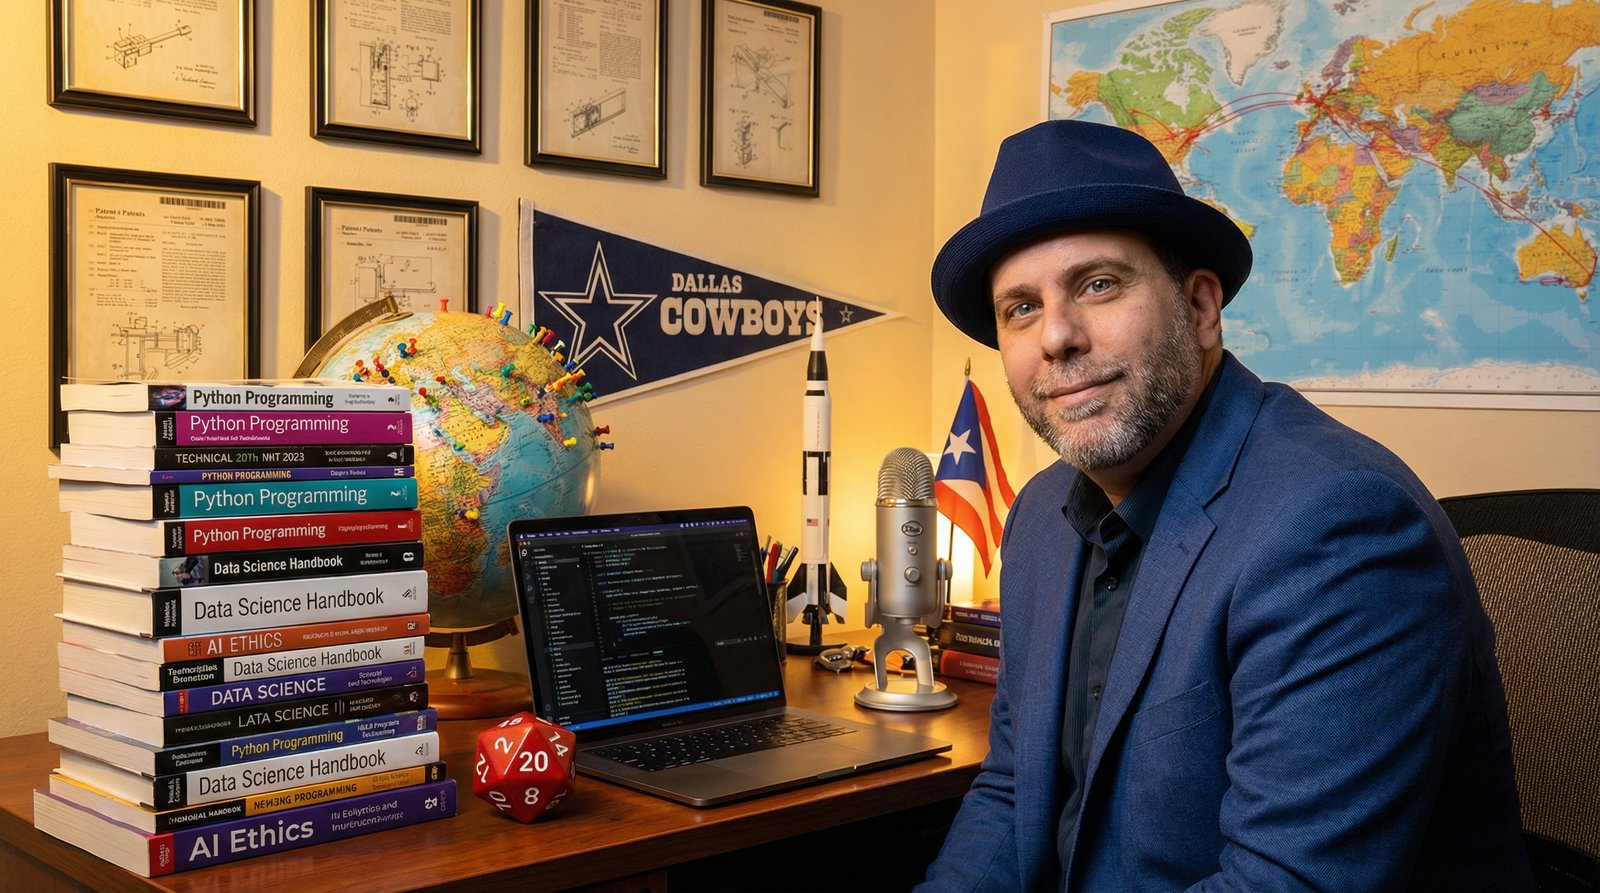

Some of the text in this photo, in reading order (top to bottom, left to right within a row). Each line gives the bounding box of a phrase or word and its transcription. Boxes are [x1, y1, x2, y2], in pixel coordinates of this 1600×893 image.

[672, 273, 742, 293] DALLAS
[660, 297, 824, 336] COWBOYS
[193, 390, 241, 411] Python
[245, 390, 334, 408] Programming
[190, 415, 246, 434] Python
[250, 416, 349, 434] Programming
[176, 453, 233, 464] TECHNICAL
[283, 452, 305, 462] 2023
[201, 470, 292, 481] PYTHON PROGRAMMING
[194, 490, 255, 511] Python
[260, 486, 367, 508] Programming
[194, 527, 239, 545] Python
[243, 524, 326, 542] Programming
[214, 561, 241, 575] Data
[242, 559, 287, 574] Science
[289, 555, 343, 570] Handbook
[194, 601, 233, 620] Data
[238, 597, 300, 615] Science
[307, 587, 384, 609] Handbook
[207, 638, 222, 655] AI
[231, 632, 283, 653] ETHICS
[234, 660, 264, 677] Data
[267, 654, 317, 673] Science
[321, 645, 382, 666] Handbook
[211, 688, 251, 706] DATA
[257, 677, 326, 699] SCIENCE
[238, 714, 270, 728] LATA
[274, 704, 329, 722] SCIENCE
[231, 730, 343, 758] Python Programming
[494, 737, 514, 754] 2
[519, 751, 548, 772] 20
[200, 773, 236, 796] Data
[242, 763, 304, 788] Science
[310, 749, 386, 777] Handbook
[294, 784, 357, 803] PROGRAMMING
[524, 787, 539, 805] 8
[382, 800, 398, 811] and
[189, 834, 218, 862] AI
[230, 819, 314, 853] Ethics
